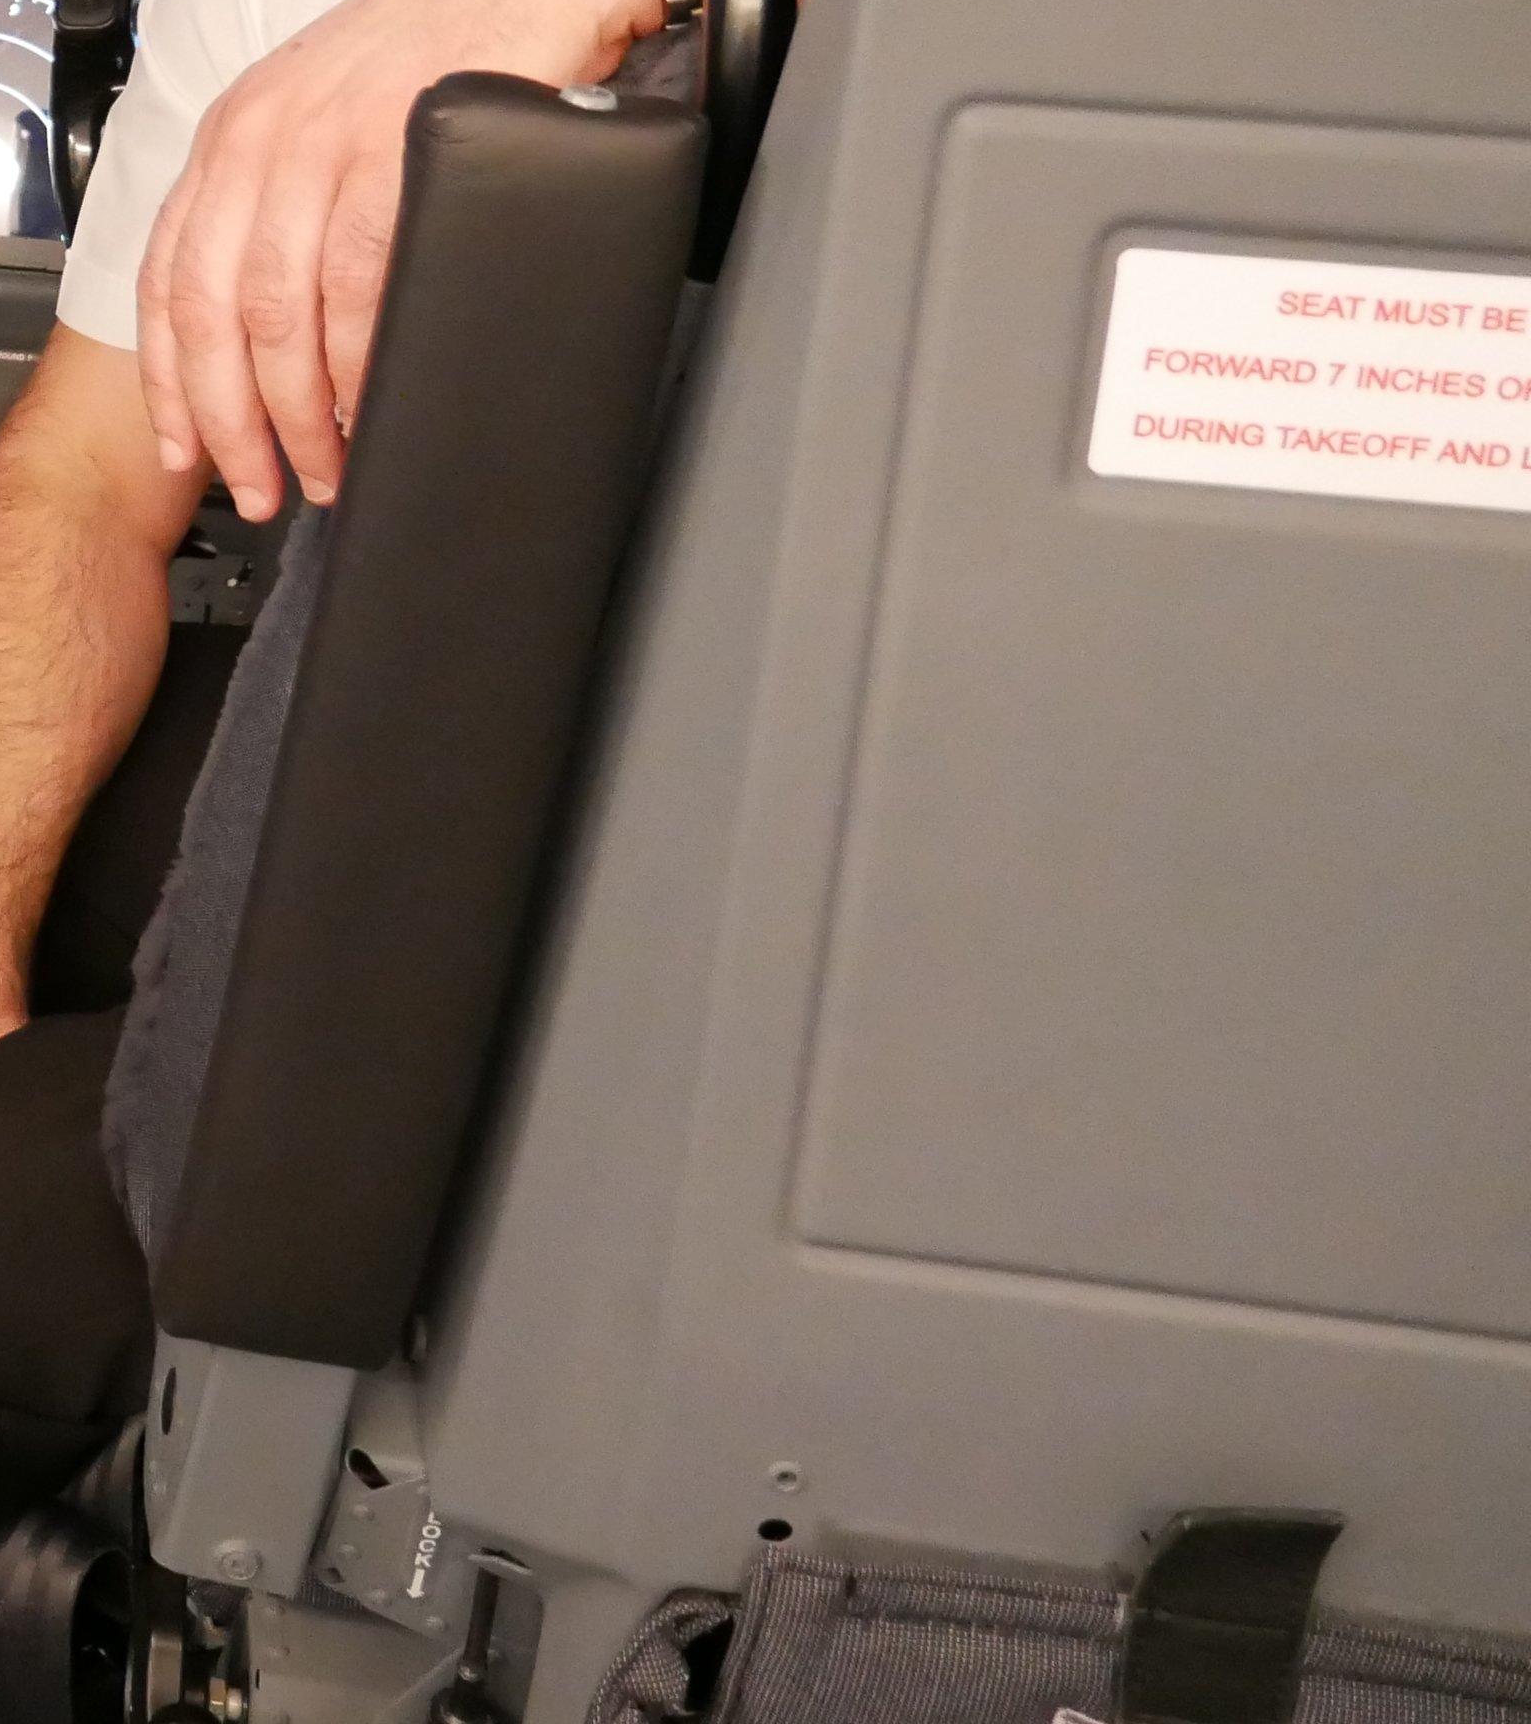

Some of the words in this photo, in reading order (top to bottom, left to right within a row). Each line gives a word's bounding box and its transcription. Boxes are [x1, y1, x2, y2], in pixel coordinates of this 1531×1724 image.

[1277, 291, 1365, 321] SEAT
[1373, 298, 1472, 328] MUST
[1481, 307, 1528, 333] BE
[1144, 348, 1316, 385] FORWARD
[1328, 362, 1345, 386] 7
[1356, 364, 1486, 399] INCHES
[1133, 414, 1264, 447] DURING
[1275, 425, 1430, 460] TAKEOFF
[1437, 440, 1511, 469] AND
[414, 1511, 442, 1569] LOCK
